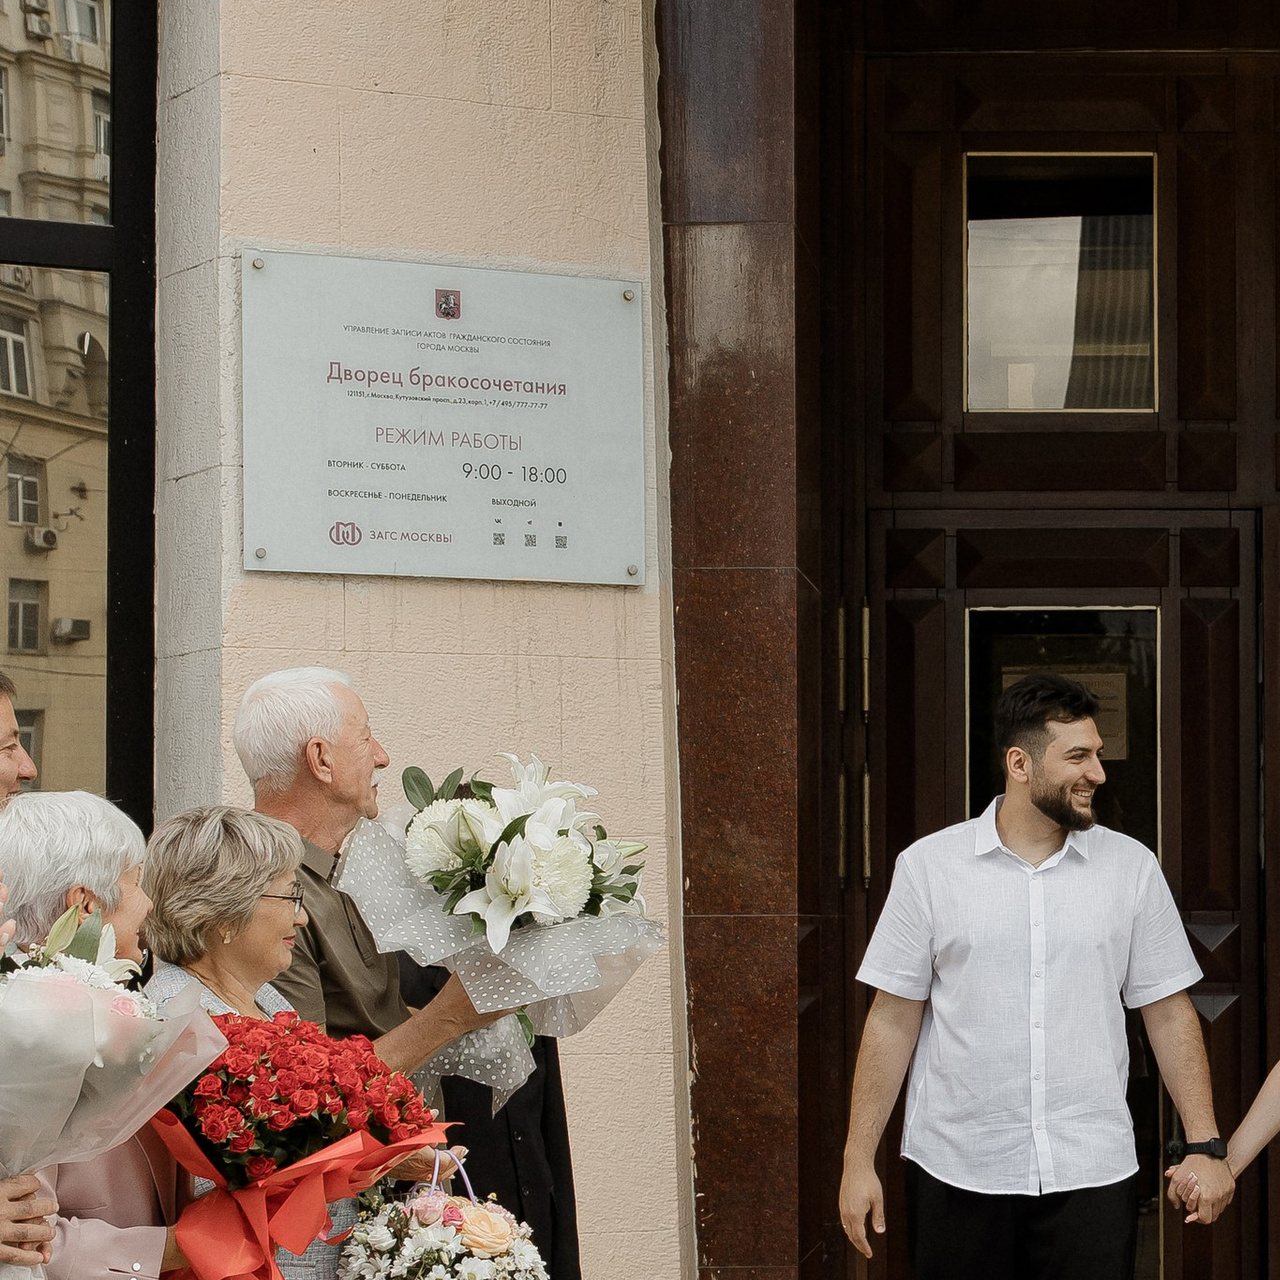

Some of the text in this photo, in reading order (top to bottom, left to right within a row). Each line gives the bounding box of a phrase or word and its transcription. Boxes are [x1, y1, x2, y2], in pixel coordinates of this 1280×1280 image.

[343, 324, 551, 347] УПРАВЛЕНИЕ ЗАПИСИ АКТОВ ГРАЖДАНСКОГО СОСТОЯНИЯ
[416, 342, 480, 354] ГОРОДА МОСКВЫ
[326, 361, 567, 396] Дворец бракосочетания
[375, 427, 522, 451] РЕЖИМ РАБОТЫ
[327, 460, 364, 469] ВТОРНИК
[370, 462, 407, 471] СУББОТА
[462, 462, 502, 481] 9:00
[521, 466, 567, 484] 18:00
[327, 489, 383, 499] ВОСКРЕСЕНЬЕ
[388, 492, 448, 502] ПОНЕДЕЛЬНИК
[491, 498, 537, 508] ВЫХОДНОЙ
[369, 530, 452, 543] ЗАГС МОСКВЫ
